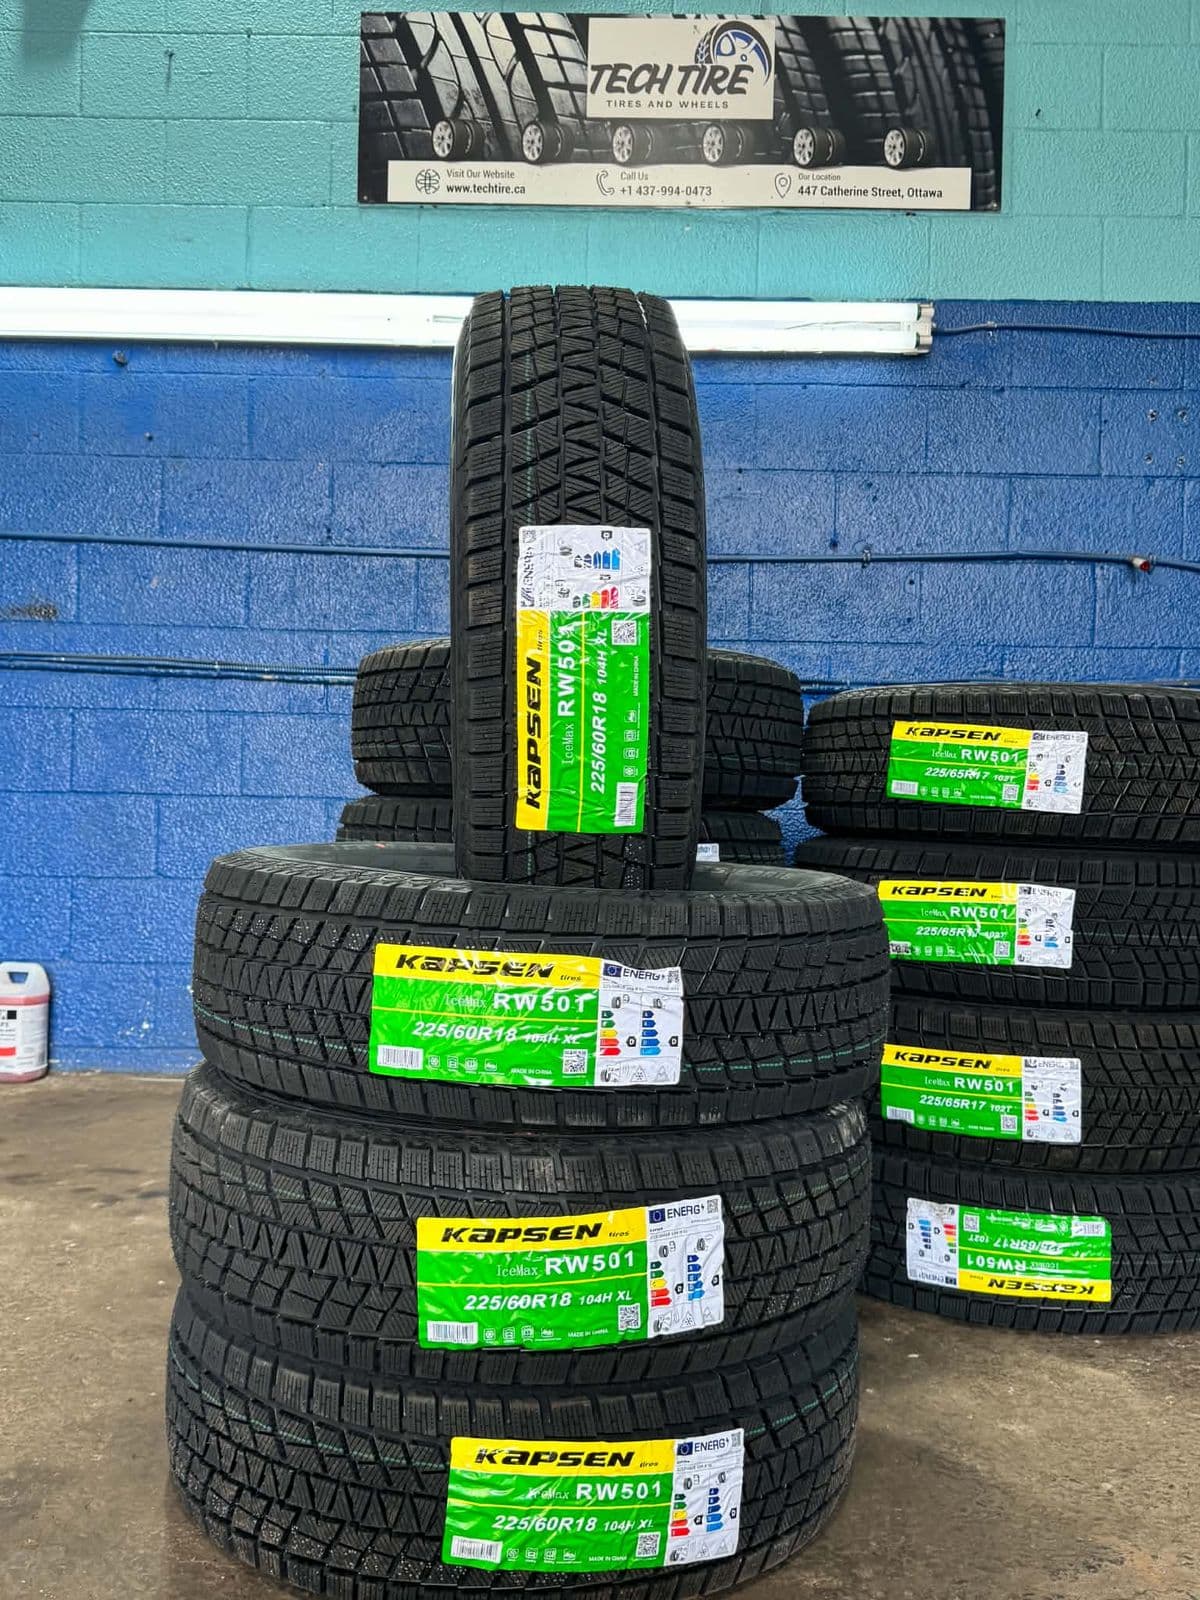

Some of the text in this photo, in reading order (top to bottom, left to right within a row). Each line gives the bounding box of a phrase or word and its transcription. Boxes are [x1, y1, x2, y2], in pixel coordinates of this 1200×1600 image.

[590, 63, 753, 95] TECH TIRE
[606, 100, 641, 108] TIRES
[679, 101, 728, 109] WHEELS
[447, 170, 515, 179] Visit Our Website
[621, 171, 648, 181] Call Us
[798, 173, 840, 181] Our Location
[446, 183, 526, 194] www.techtire.ca
[619, 186, 712, 197] +1 437-994-0473
[798, 186, 943, 199] 447 Catherine Street, Ottawa
[557, 625, 575, 765] IceMax RW501
[591, 628, 608, 794] 225/60R18 104H XL
[961, 750, 1019, 762] RW501
[924, 767, 989, 780] 225/65R17
[950, 907, 1010, 919] RW501
[493, 993, 587, 1013] RW501
[412, 1021, 518, 1042] 225/60R18
[954, 1077, 1015, 1092] RW501
[919, 1094, 1013, 1113] 225/65R17 102T
[666, 1204, 701, 1219] ENERG
[496, 1253, 635, 1276] IceMax RW501
[966, 1254, 1027, 1270] RW501
[464, 1290, 633, 1311] 225/60R18 104H XL
[694, 1438, 725, 1453] ENERG
[576, 1482, 661, 1500] RW501
[491, 1515, 654, 1532] 225/60R18 104H XL
